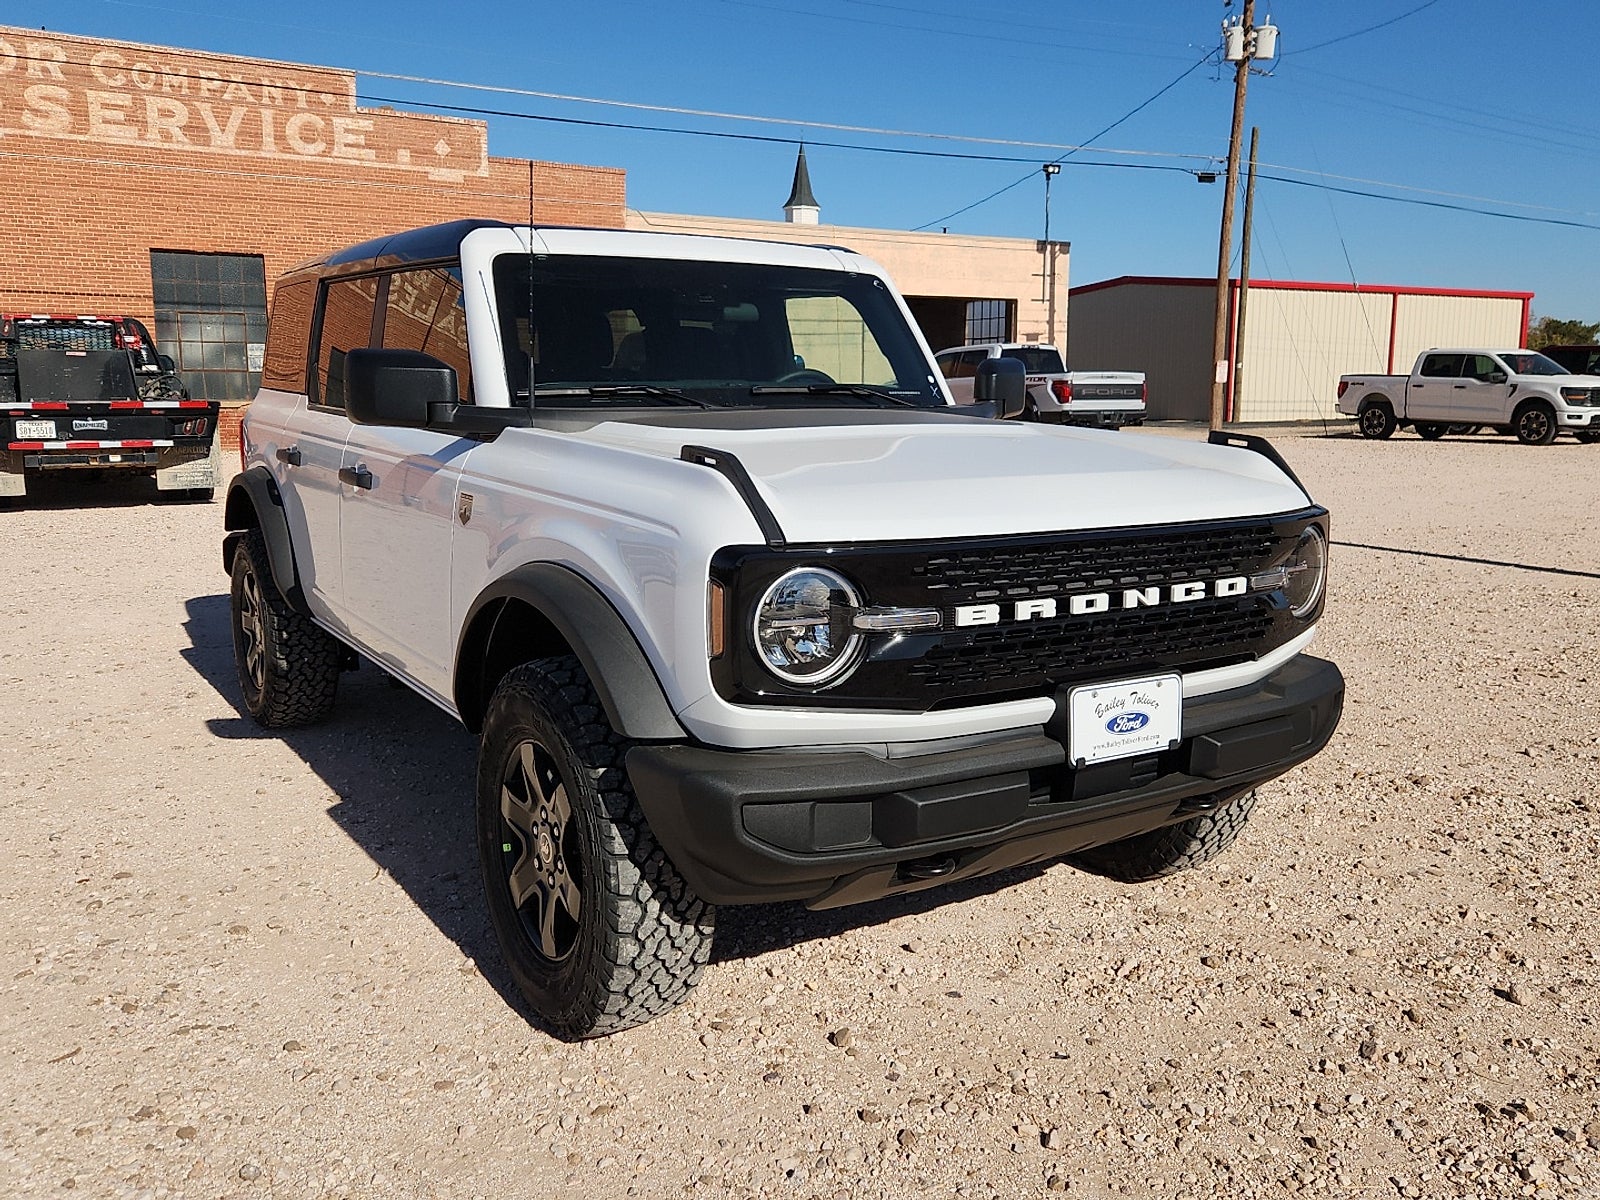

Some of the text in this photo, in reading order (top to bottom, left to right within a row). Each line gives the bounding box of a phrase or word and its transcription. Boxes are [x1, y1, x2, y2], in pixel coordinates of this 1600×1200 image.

[89, 51, 315, 108] COMPANY
[1081, 388, 1137, 396] FORD
[955, 576, 1248, 627] BRONCO
[1095, 691, 1160, 718] Bailey Toliver
[1113, 713, 1143, 733] Ford
